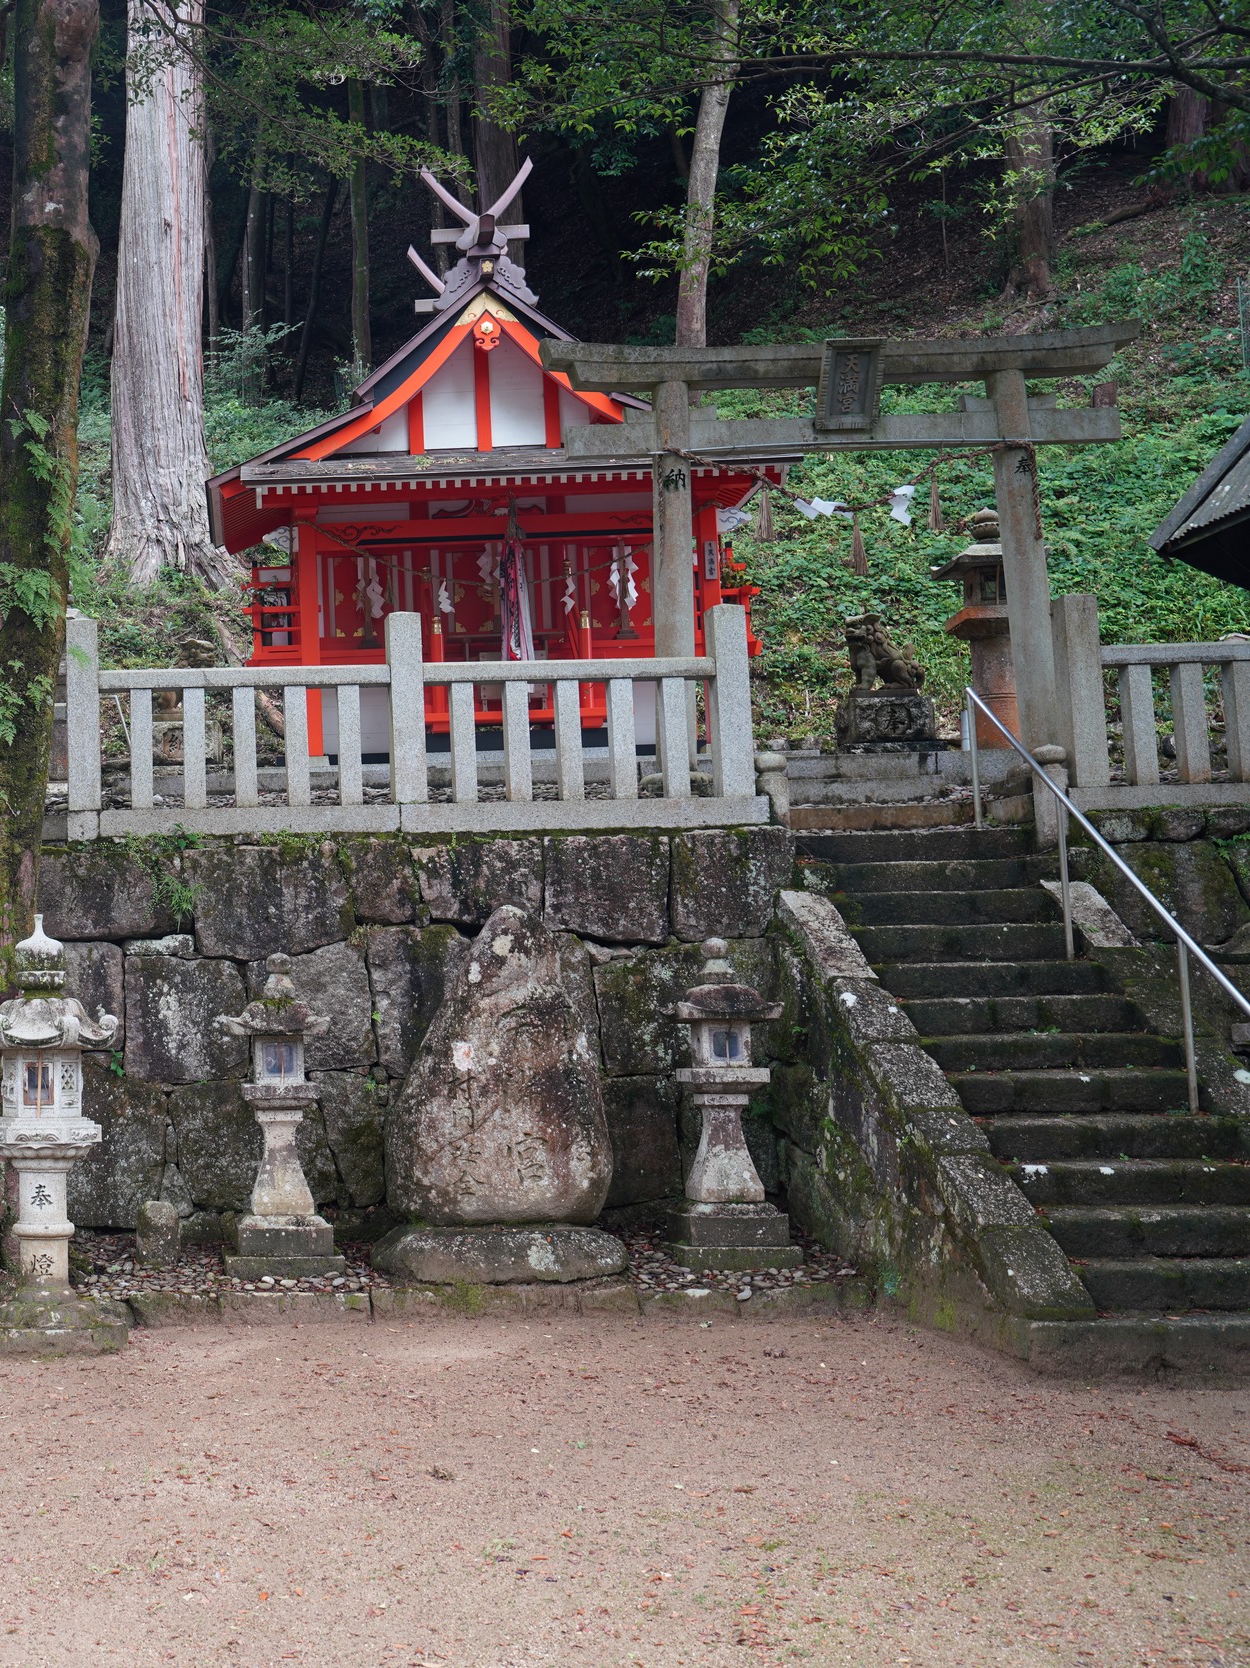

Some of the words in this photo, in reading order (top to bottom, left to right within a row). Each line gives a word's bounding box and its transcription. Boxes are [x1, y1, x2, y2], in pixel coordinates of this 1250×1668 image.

[837, 354, 861, 413] 天満宮
[1014, 456, 1033, 476] 奉
[663, 468, 686, 491] 納
[30, 1183, 54, 1211] 奉
